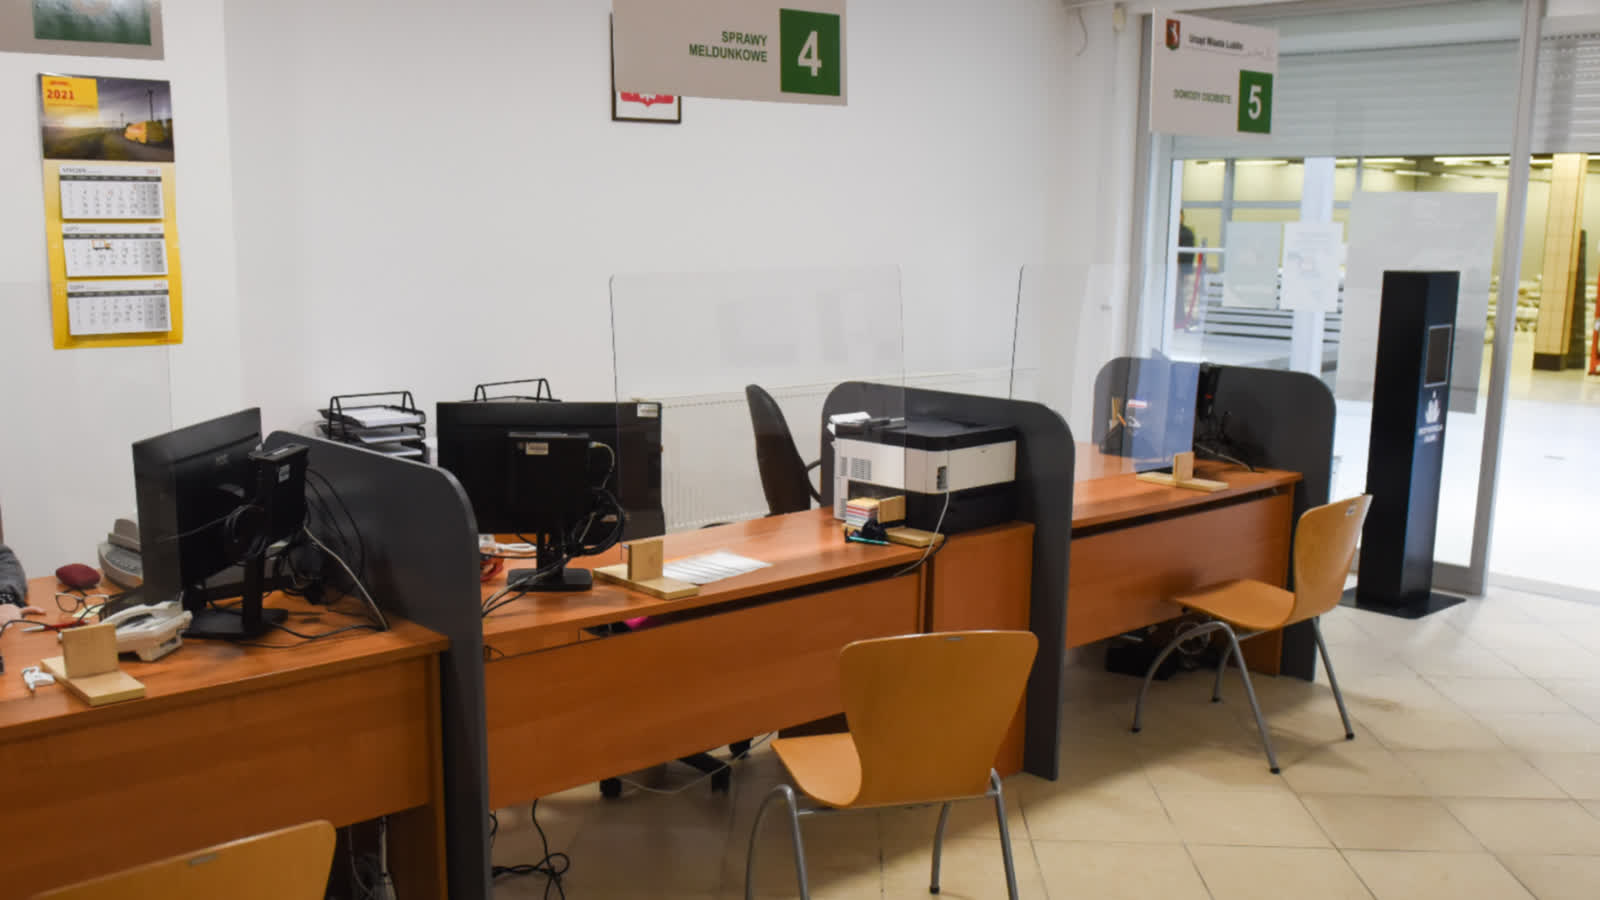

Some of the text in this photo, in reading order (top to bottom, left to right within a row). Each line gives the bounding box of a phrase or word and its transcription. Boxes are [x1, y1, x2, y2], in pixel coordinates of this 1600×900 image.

[721, 31, 767, 46] SPRAWY
[689, 44, 768, 62] MELDUNKOWE
[797, 30, 822, 77] 4
[47, 89, 75, 100] 2021
[1248, 84, 1262, 119] 5
